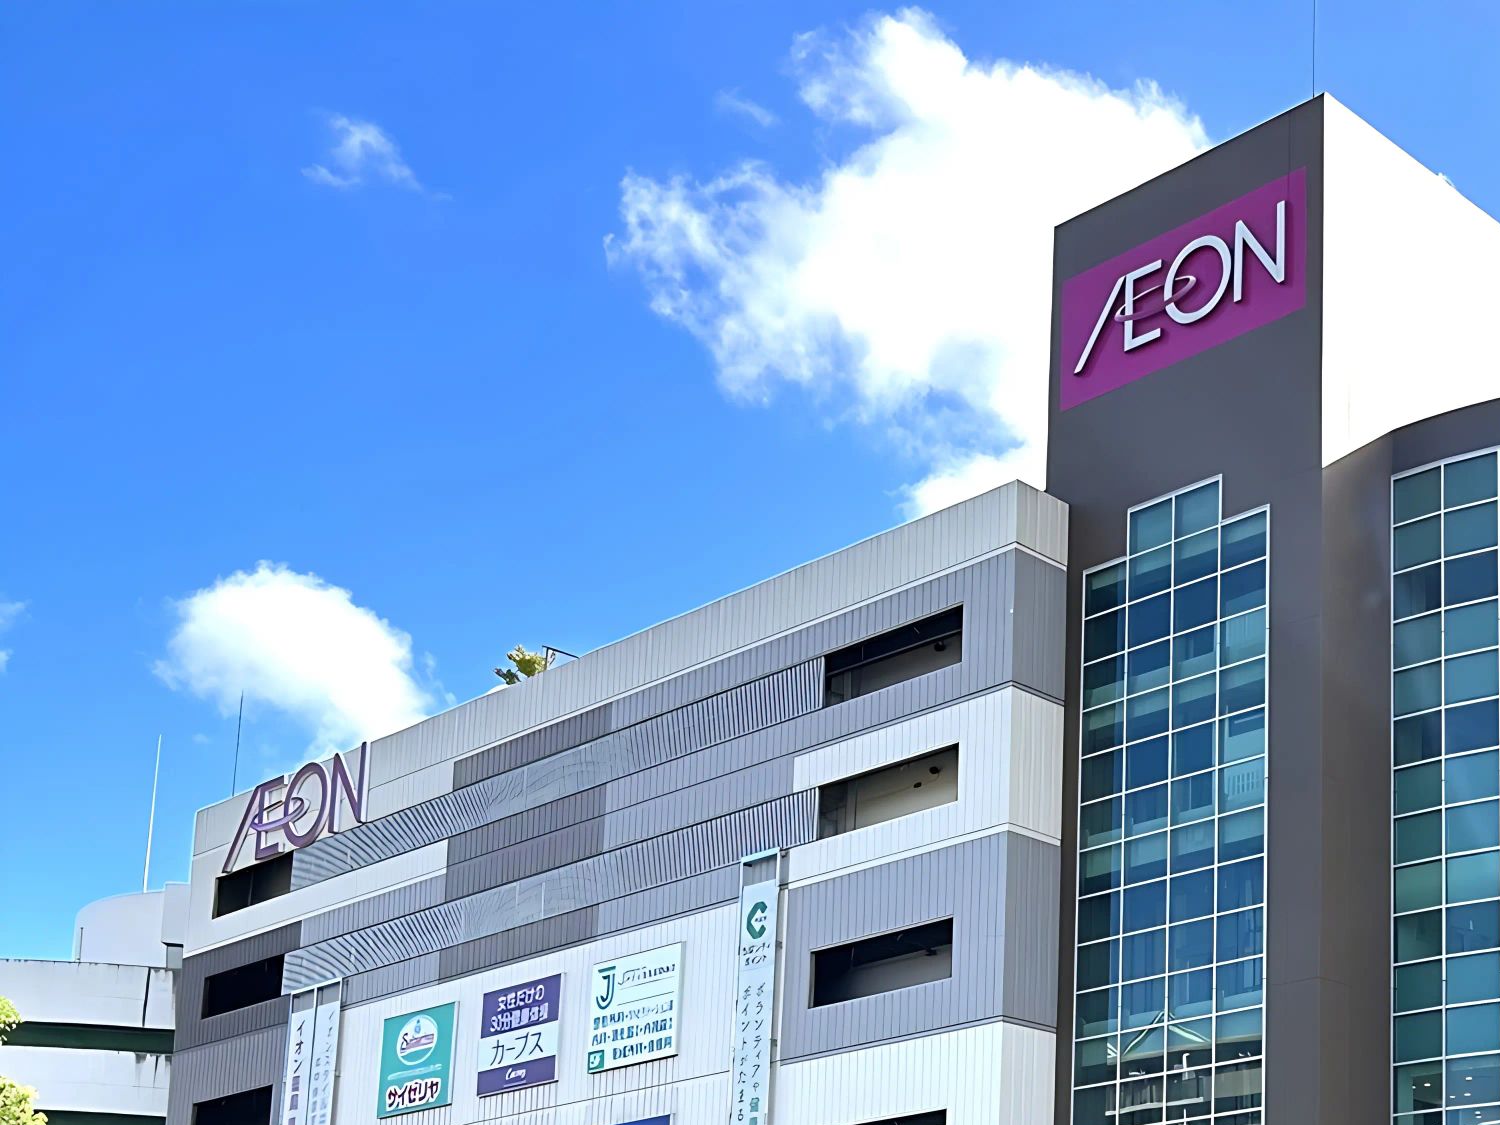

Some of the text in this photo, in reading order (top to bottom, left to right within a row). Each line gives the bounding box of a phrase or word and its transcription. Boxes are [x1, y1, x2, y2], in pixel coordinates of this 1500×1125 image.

[489, 1031, 544, 1066] カーブス
[387, 1080, 440, 1108] サイゼリヤ
